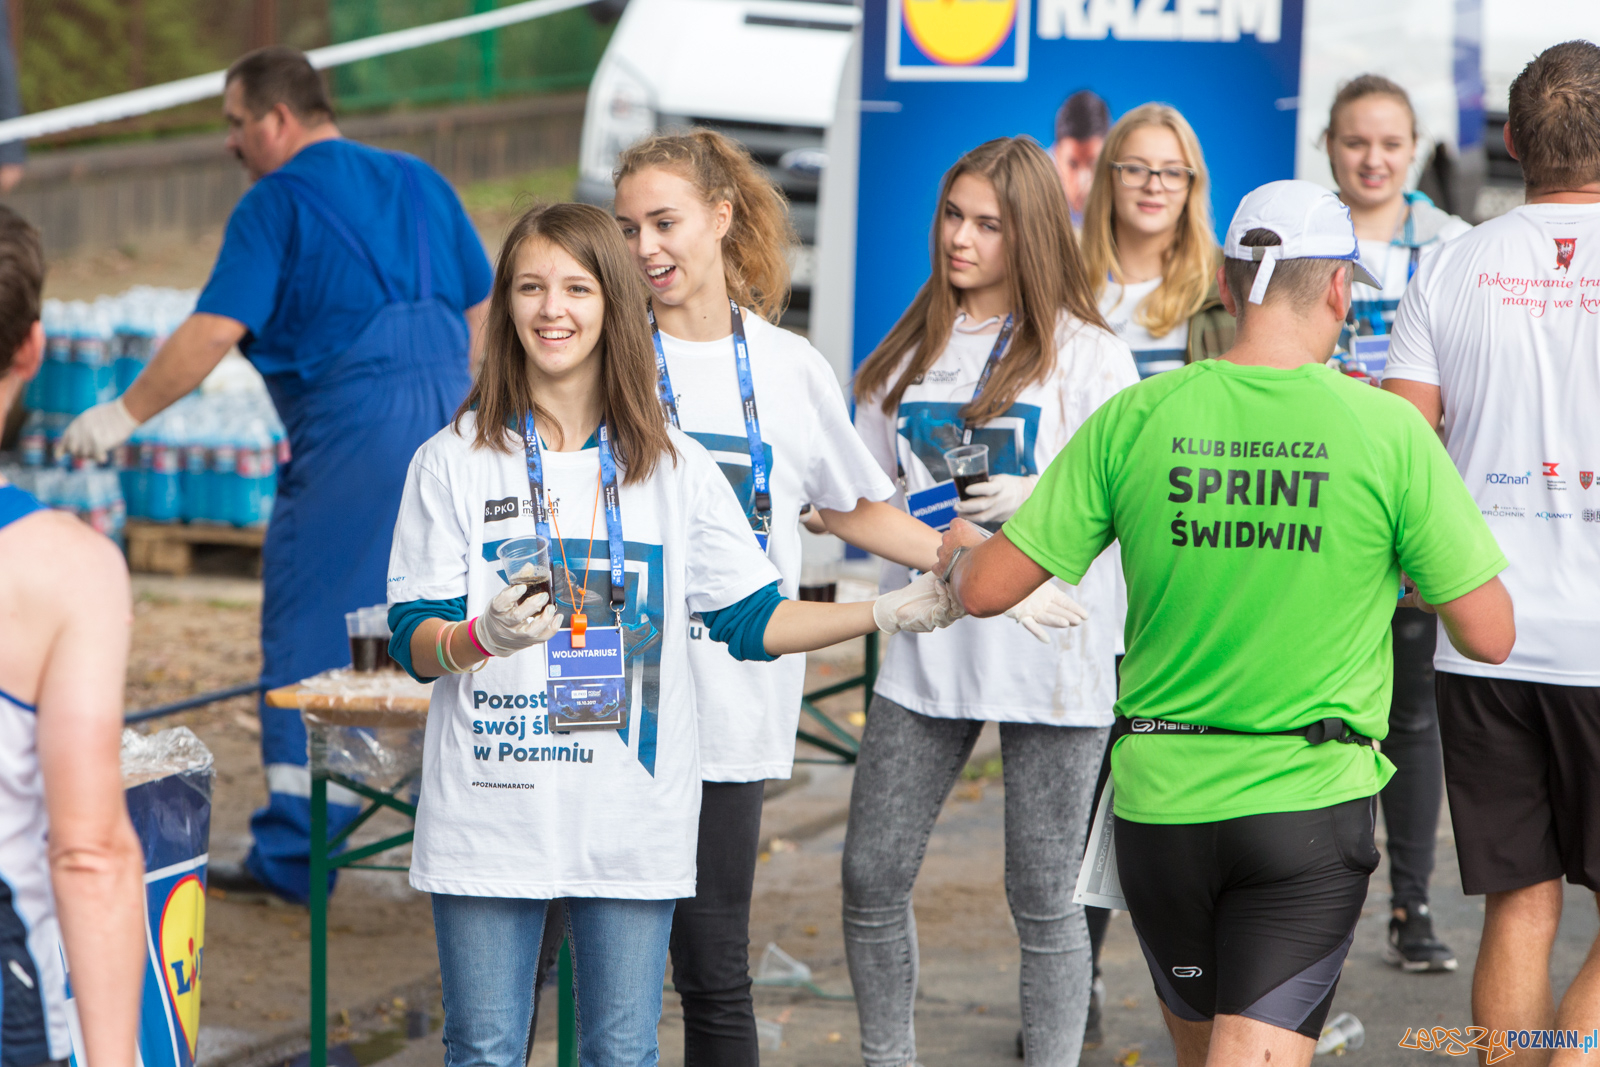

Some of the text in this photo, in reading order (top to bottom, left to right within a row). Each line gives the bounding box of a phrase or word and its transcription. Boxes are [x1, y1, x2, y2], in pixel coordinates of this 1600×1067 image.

[1478, 272, 1574, 296] Pokonywanie
[1502, 297, 1548, 318] mamy
[1553, 300, 1574, 309] we
[1172, 437, 1329, 459] KLUB BIEGACZA
[1168, 466, 1329, 508] SPRINT
[494, 502, 515, 515] PKO
[912, 497, 960, 517] WOLONTARIU
[1171, 511, 1322, 553] ŚWIDWIN
[552, 649, 617, 659] WOLONTARIUSZ
[473, 690, 548, 709] Pozost
[473, 715, 526, 741] swój
[474, 745, 491, 761] w
